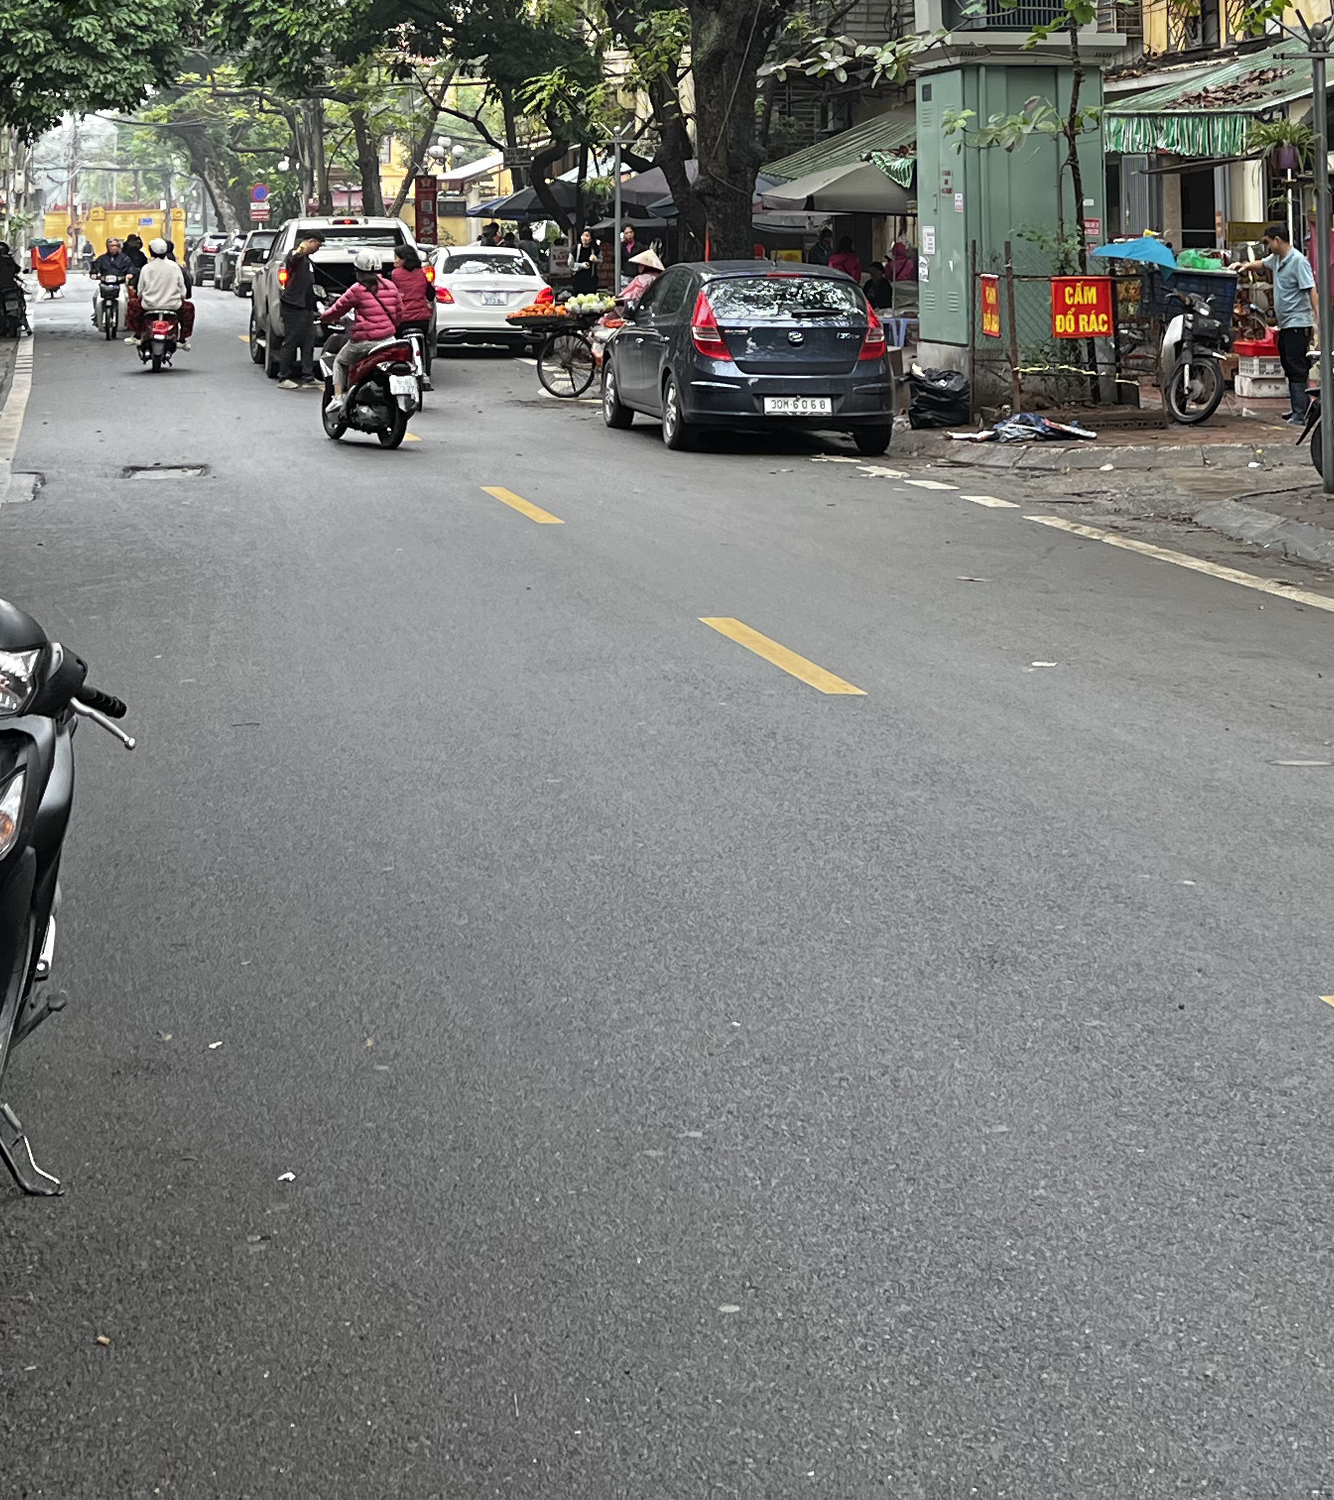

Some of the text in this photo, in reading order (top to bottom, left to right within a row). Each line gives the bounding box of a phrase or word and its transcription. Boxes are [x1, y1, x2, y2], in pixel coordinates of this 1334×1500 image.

[1064, 280, 1097, 305] CẤM
[1055, 307, 1108, 333] ĐỔ RÁC
